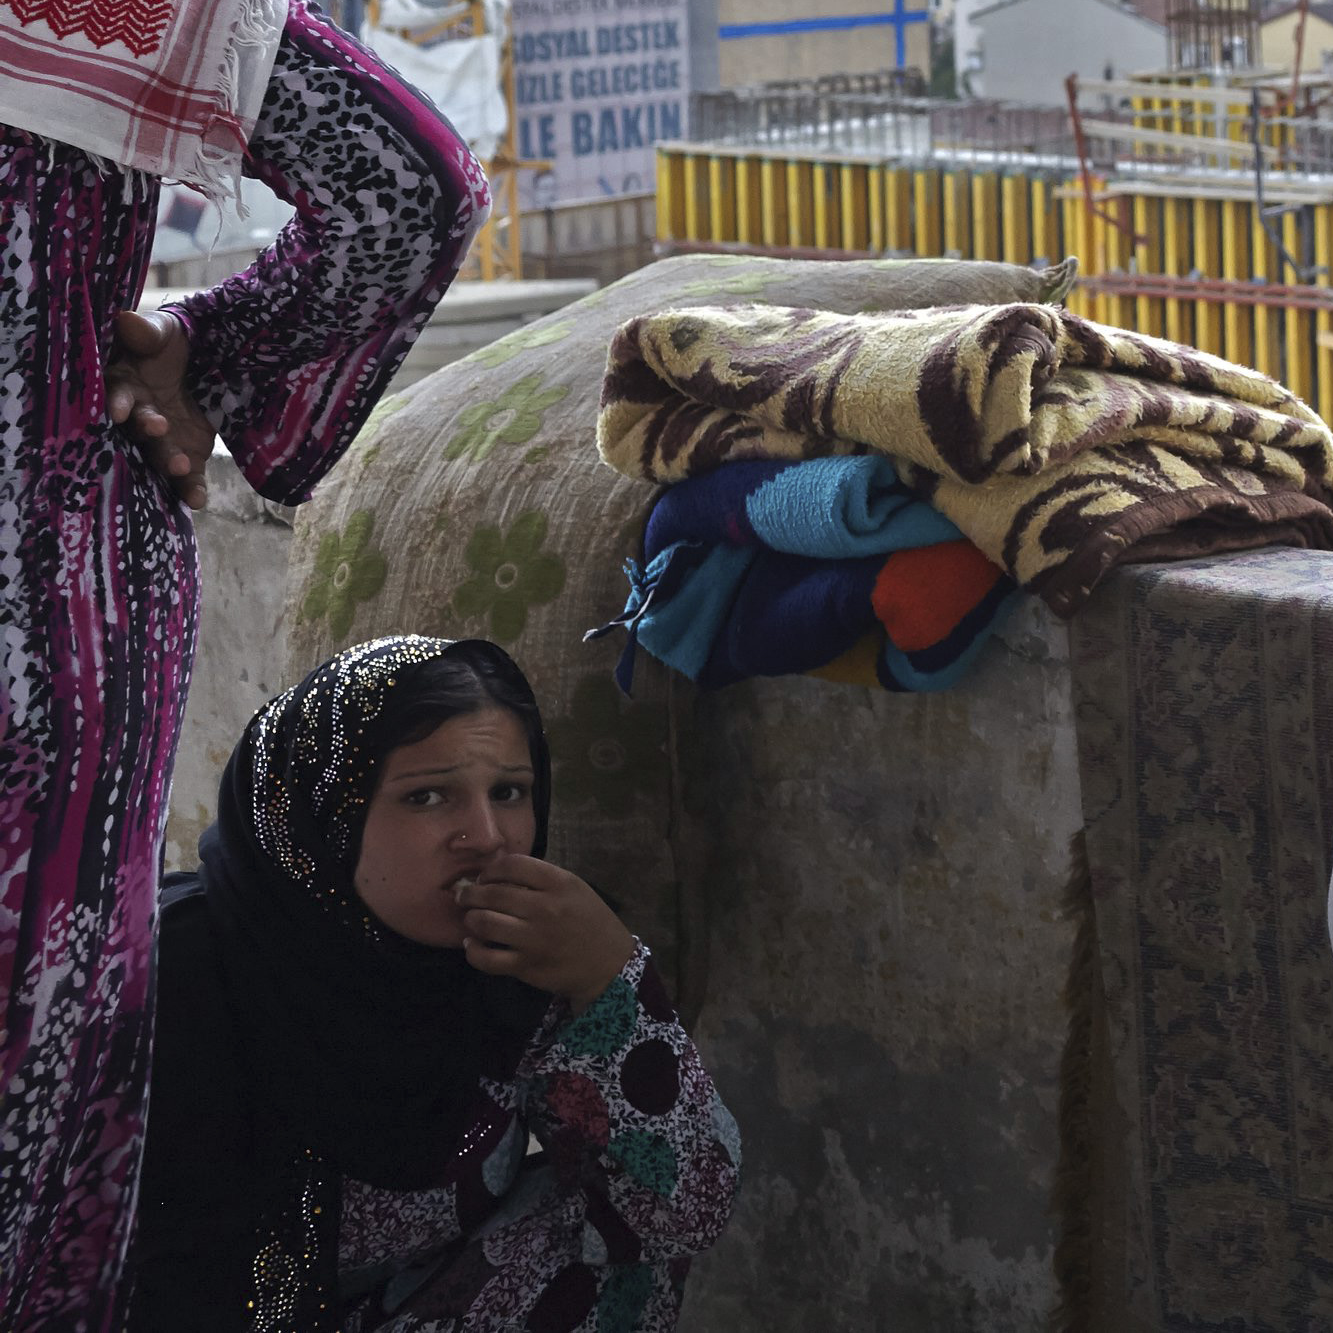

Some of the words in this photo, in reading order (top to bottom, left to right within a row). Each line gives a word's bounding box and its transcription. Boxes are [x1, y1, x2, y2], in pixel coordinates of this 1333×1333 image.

[597, 22, 679, 55] DESTEK
[571, 58, 680, 99] GELECEĞE
[572, 102, 680, 156] BAKIN
